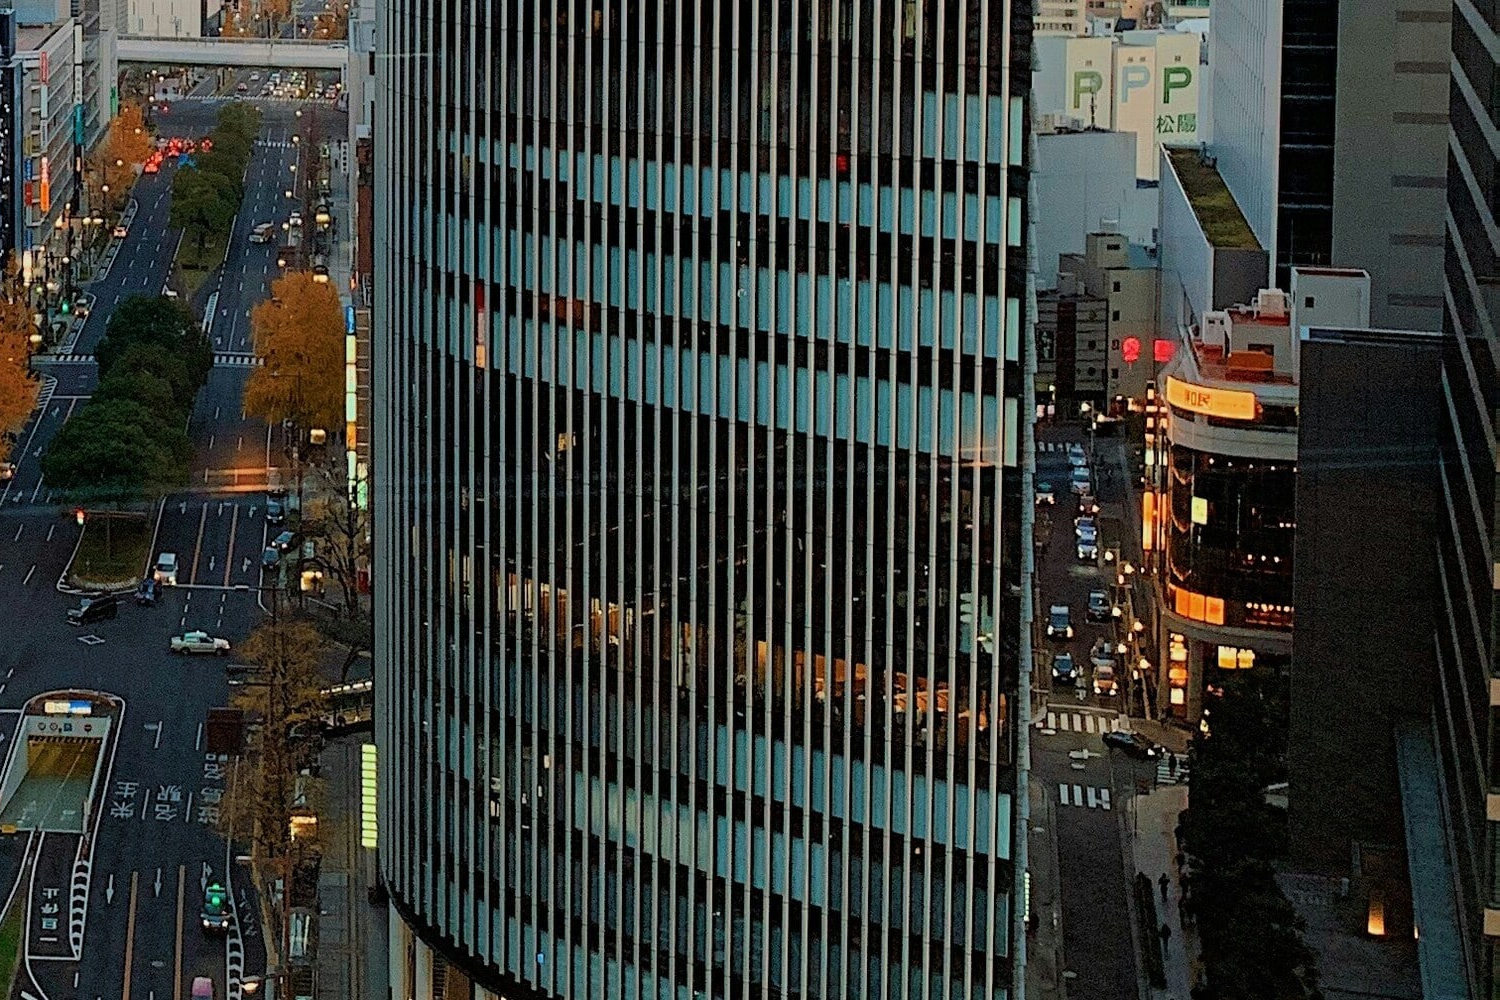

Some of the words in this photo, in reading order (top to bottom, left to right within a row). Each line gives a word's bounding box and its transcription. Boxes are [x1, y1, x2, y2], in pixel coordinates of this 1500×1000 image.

[1073, 70, 1103, 109] P
[1122, 65, 1151, 103] P
[1163, 66, 1192, 104] P
[1156, 113, 1197, 134] 松陽
[40, 887, 60, 942] 一旦停止
